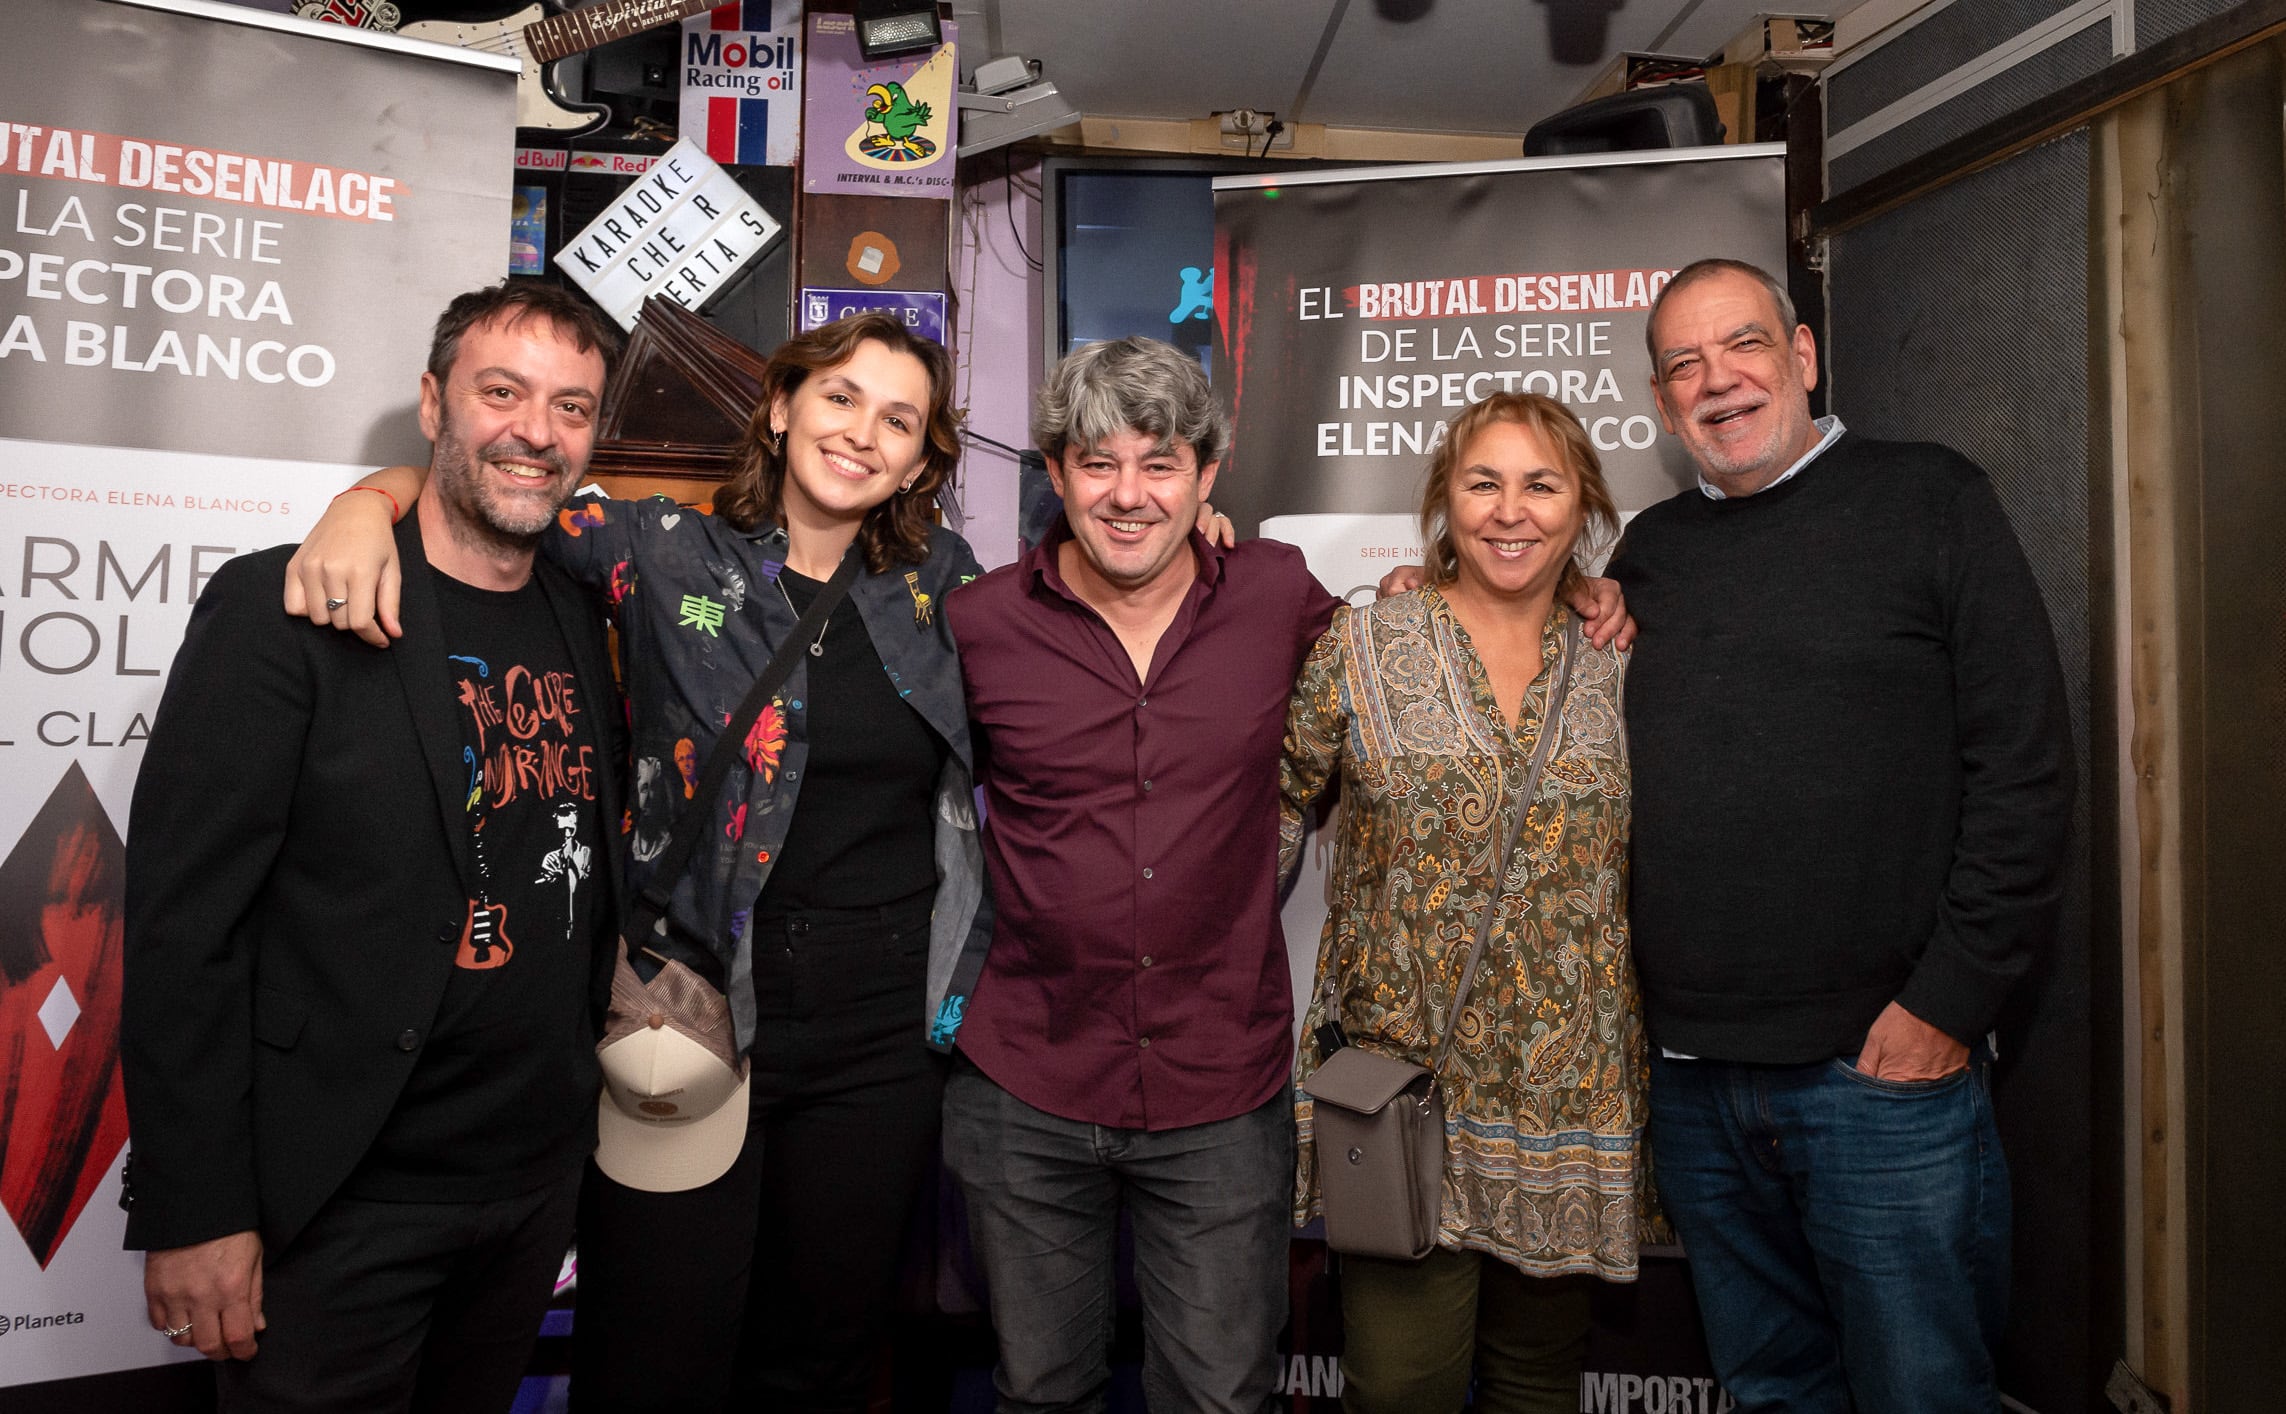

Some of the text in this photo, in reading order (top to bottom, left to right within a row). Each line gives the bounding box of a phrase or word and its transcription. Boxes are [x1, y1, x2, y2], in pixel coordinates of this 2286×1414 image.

[687, 32, 794, 70] Mobil
[686, 68, 794, 96] Racing oil
[532, 152, 565, 169] Bull
[613, 156, 647, 172] Red
[837, 173, 880, 183] INTERVAL
[884, 176, 891, 184] &
[118, 140, 394, 221] DESENLACE
[16, 189, 284, 265] LA SERIE
[573, 158, 693, 273] KARAOKE
[739, 211, 765, 236] S
[627, 194, 720, 282] CHE R
[1300, 268, 1669, 320] EL BRUTAL DESENLAC
[64, 319, 336, 388] BLANCO
[1361, 321, 1612, 362] DE LA SERIE
[1339, 367, 1623, 409] INSPECTORA
[1317, 420, 1450, 457] ELENA
[108, 491, 175, 507] ELENA
[185, 496, 272, 514] BLANCO
[280, 502, 290, 515] 5
[1361, 547, 1399, 557] SERIE
[677, 594, 727, 638] 東
[457, 665, 581, 756] THE CURE
[14, 1311, 84, 1331] Planeta
